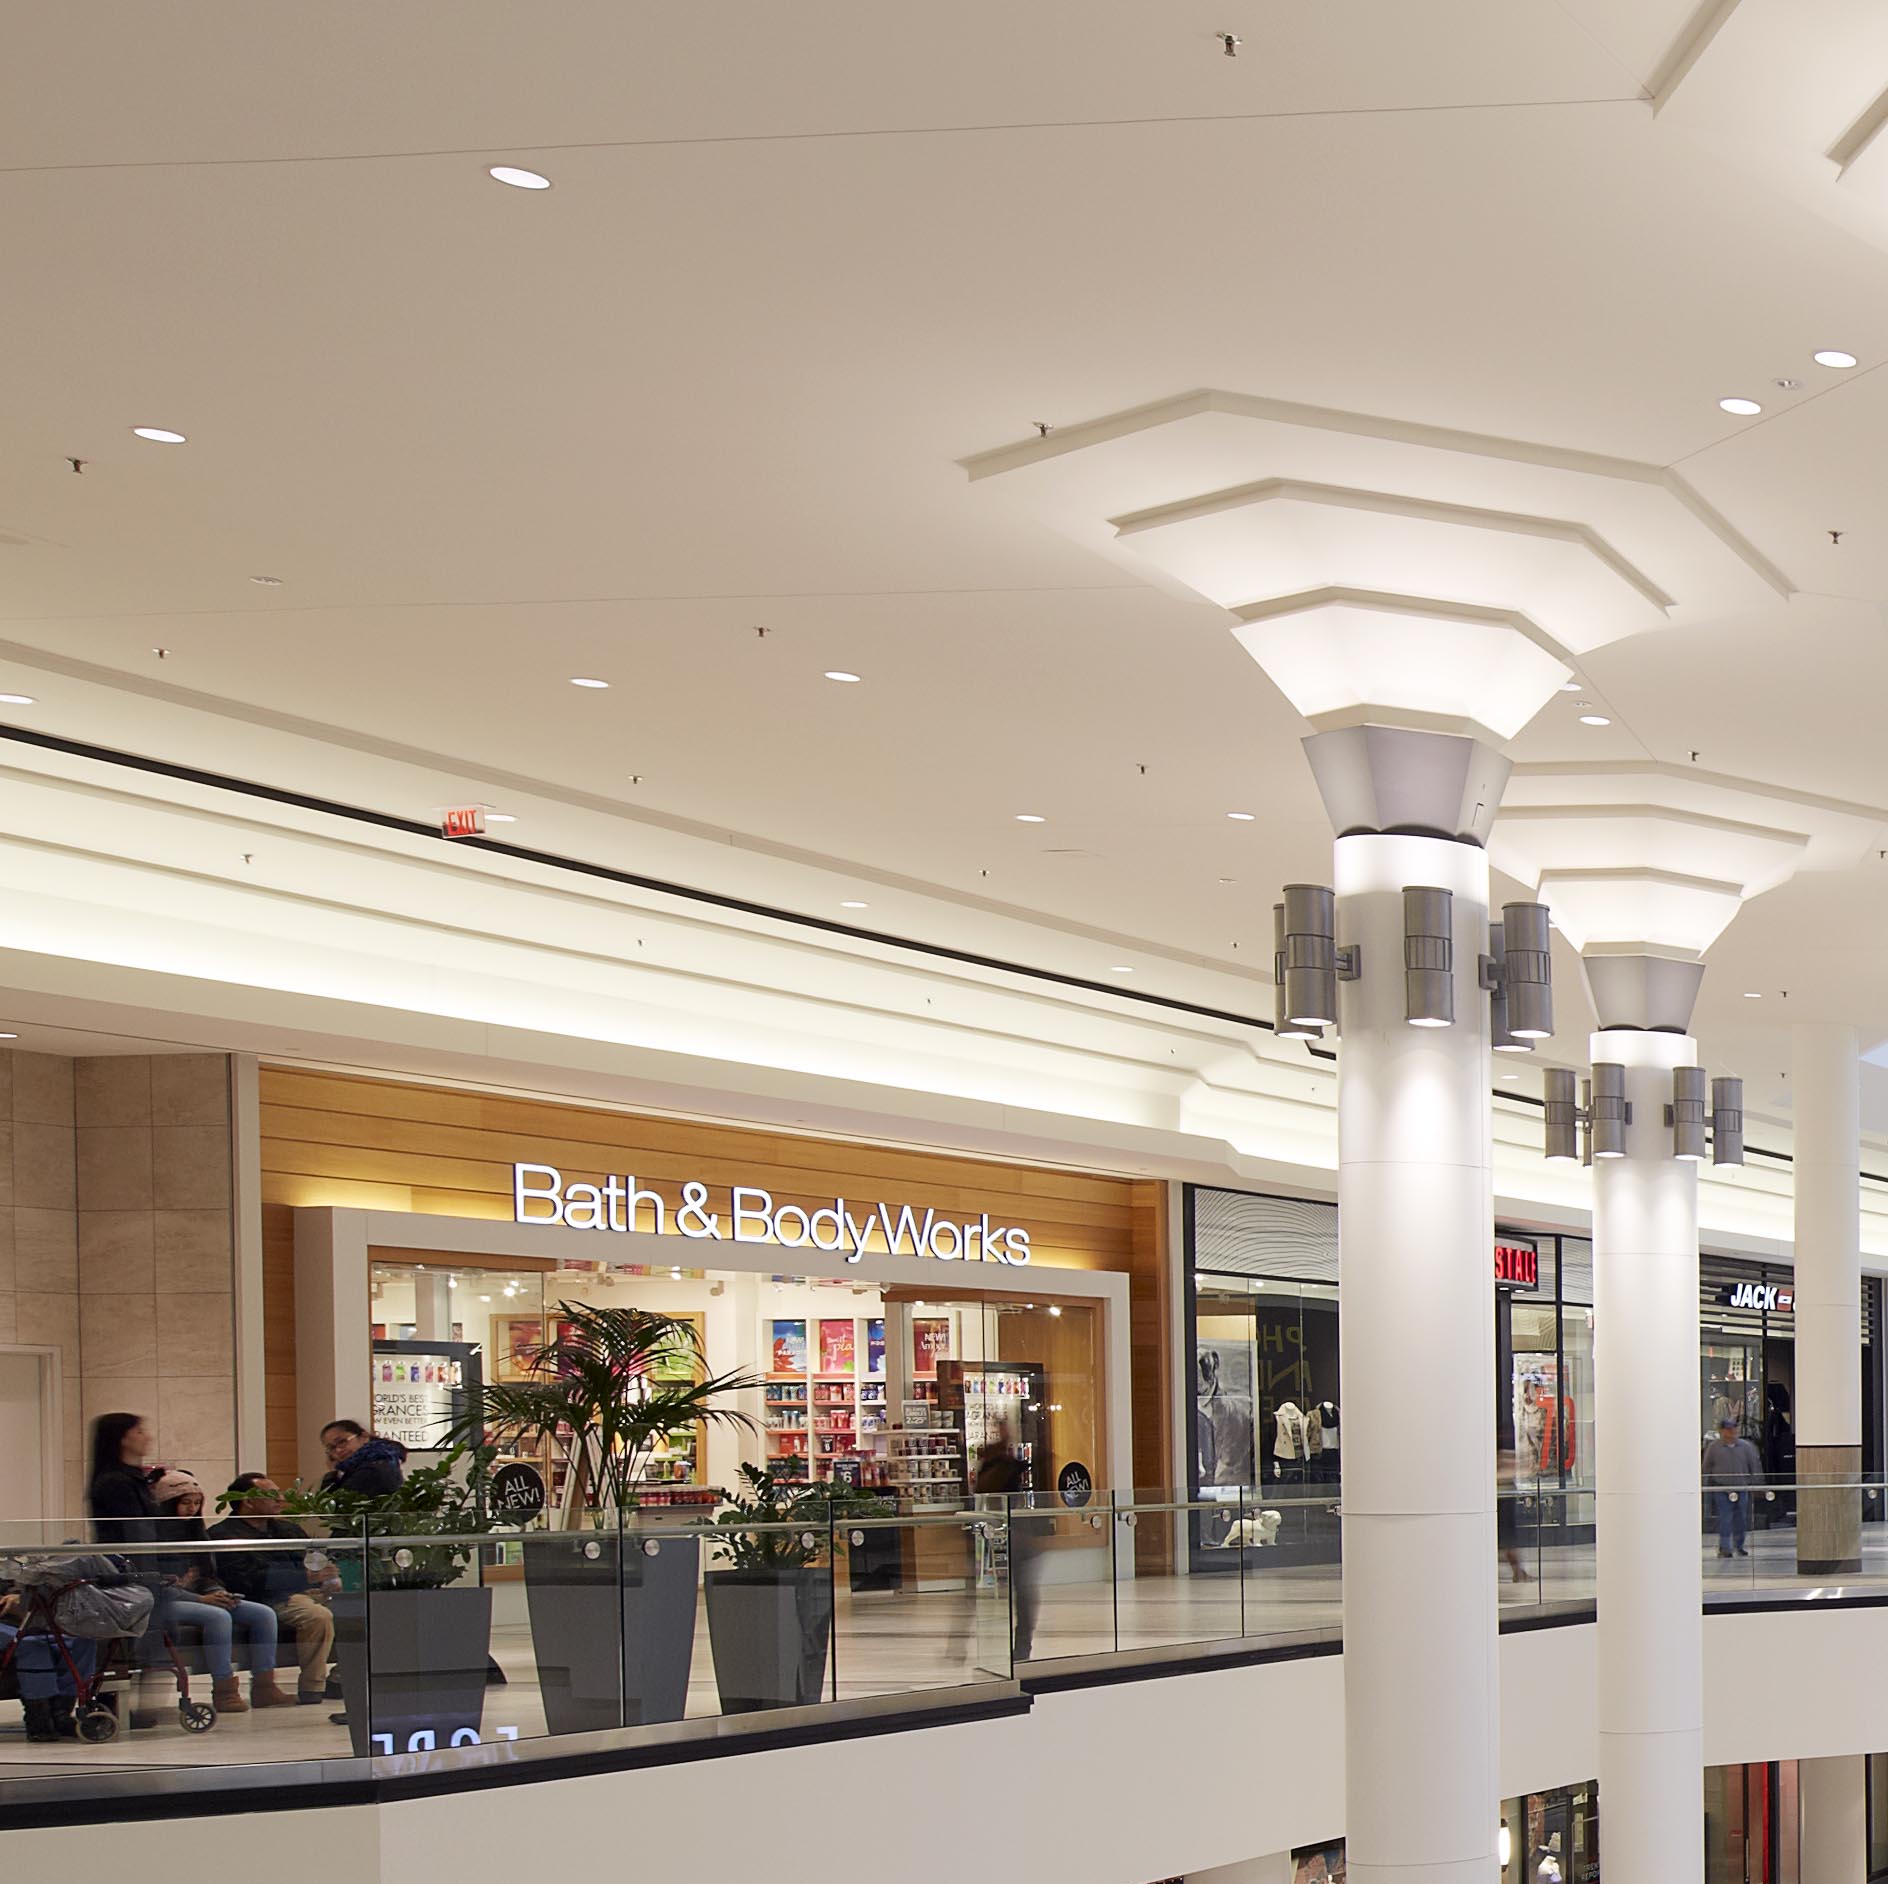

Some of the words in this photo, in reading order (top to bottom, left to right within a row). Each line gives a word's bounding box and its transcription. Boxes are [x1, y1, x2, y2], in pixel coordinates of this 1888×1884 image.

[447, 810, 477, 836] EXIT
[513, 1162, 665, 1235] Bath
[675, 1180, 722, 1241] &
[731, 1186, 878, 1263] Body
[878, 1201, 1031, 1267] Works
[1731, 1283, 1778, 1310] JACK
[375, 1393, 407, 1403] ORLD'S
[505, 1475, 530, 1495] ALL
[1067, 1471, 1081, 1489] ALL
